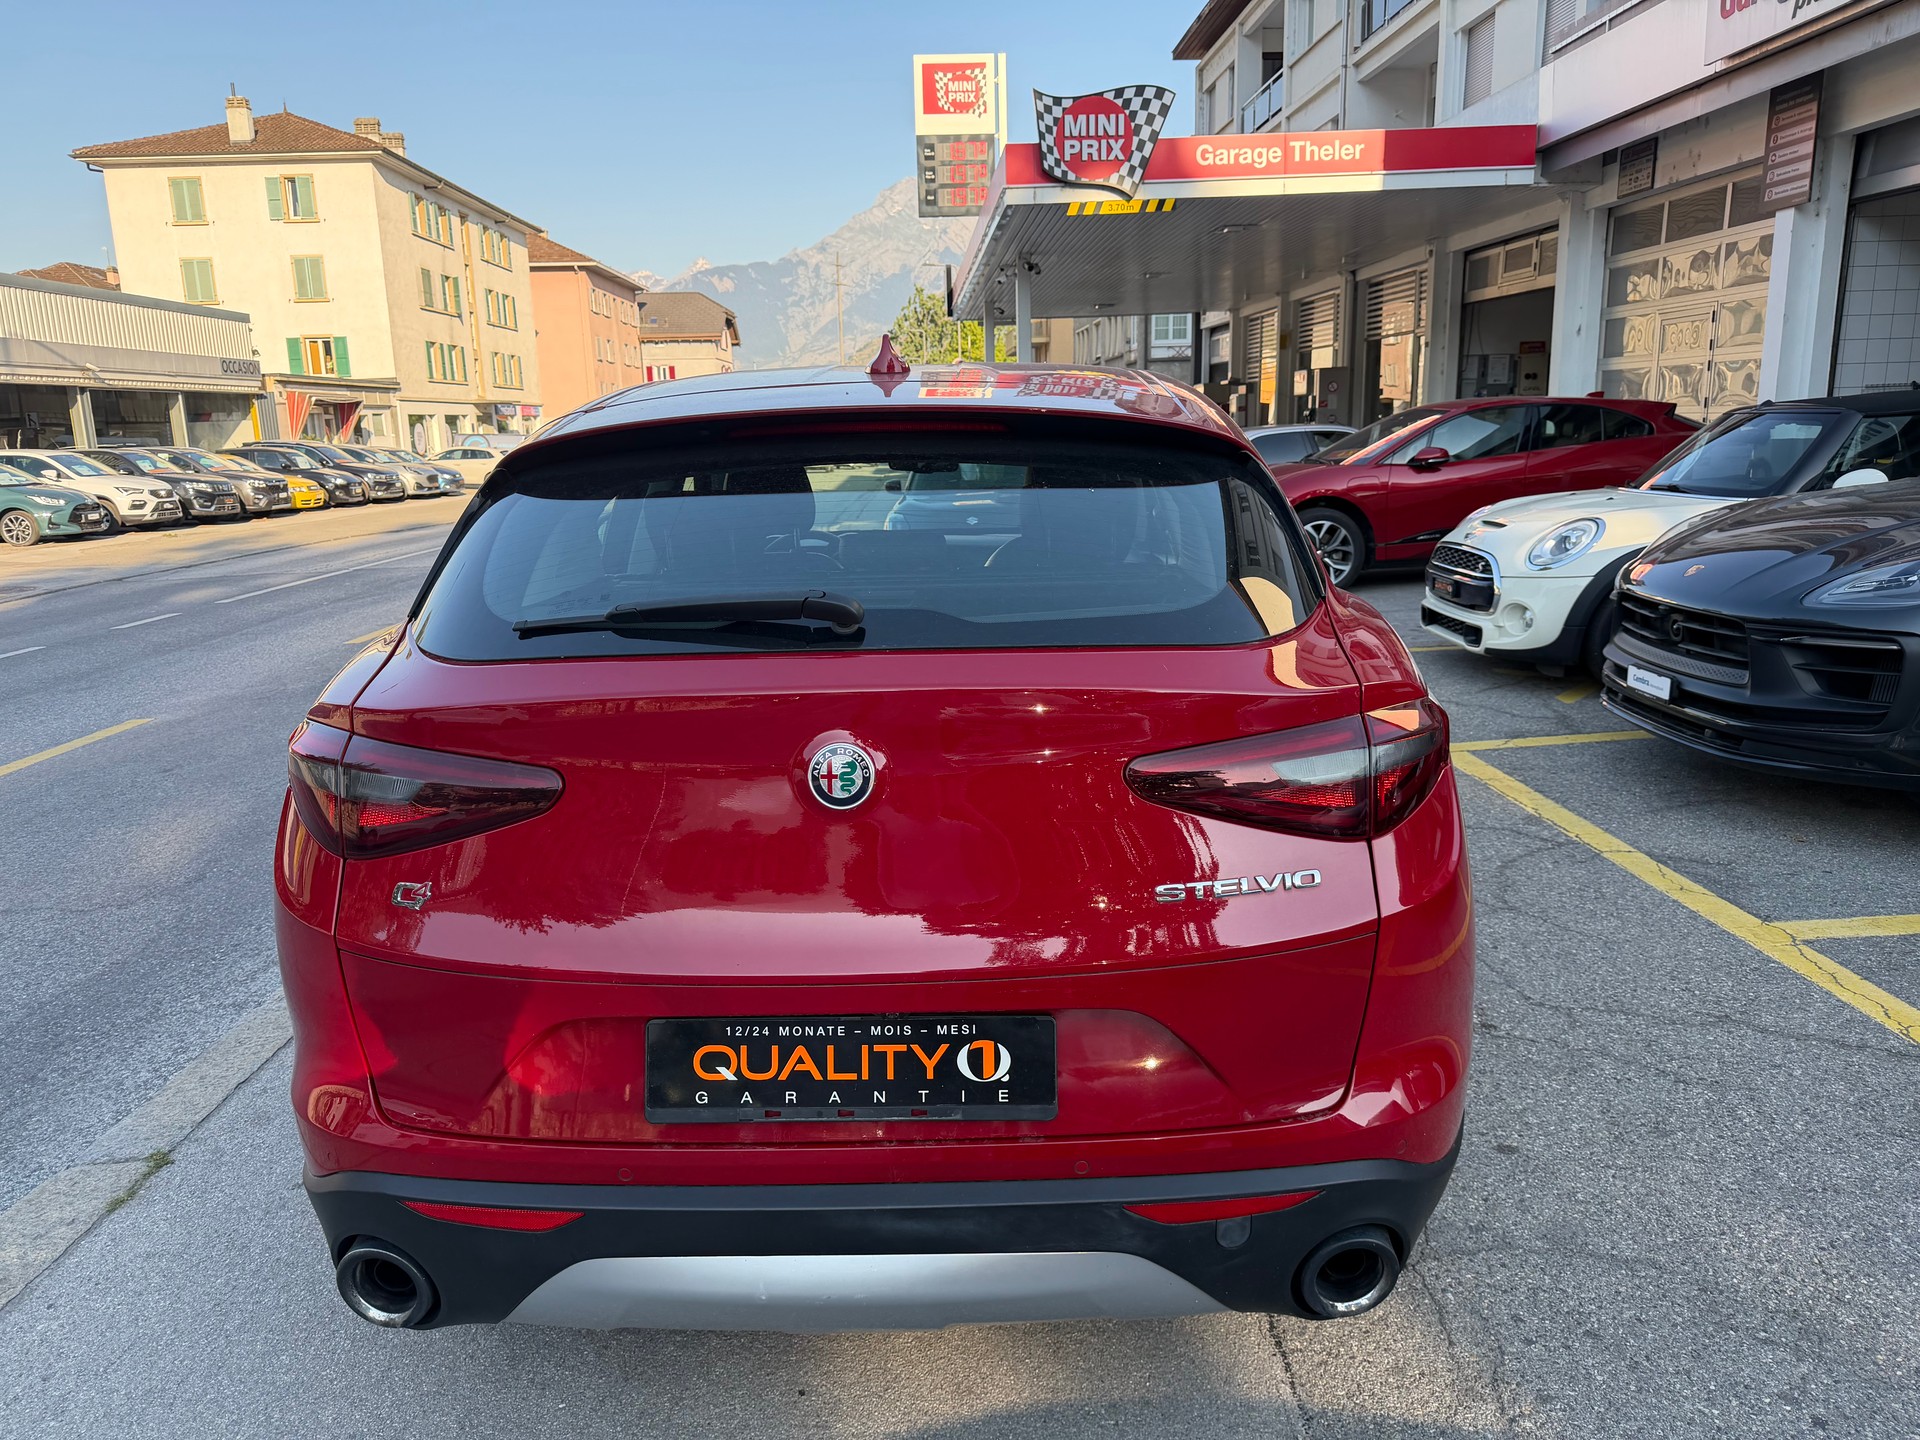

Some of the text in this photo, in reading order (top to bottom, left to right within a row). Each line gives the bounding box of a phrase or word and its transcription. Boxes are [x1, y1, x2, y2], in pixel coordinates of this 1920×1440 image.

[948, 80, 976, 91] MINI
[948, 92, 976, 102] PRIX
[1063, 113, 1125, 138] MINI
[1063, 138, 1126, 162] PRIX
[1195, 140, 1365, 169] Garage Theler
[221, 360, 261, 375] OCCASION
[813, 748, 870, 777] ALFA ROMEO
[1155, 869, 1322, 903] STELVIO
[725, 1025, 770, 1037] 12/24
[778, 1025, 846, 1037] MONATE
[870, 1025, 912, 1036] MOIS
[936, 1024, 977, 1036] MESI
[692, 1043, 951, 1081] QUALITY
[695, 1089, 1010, 1104] GARANTIE
